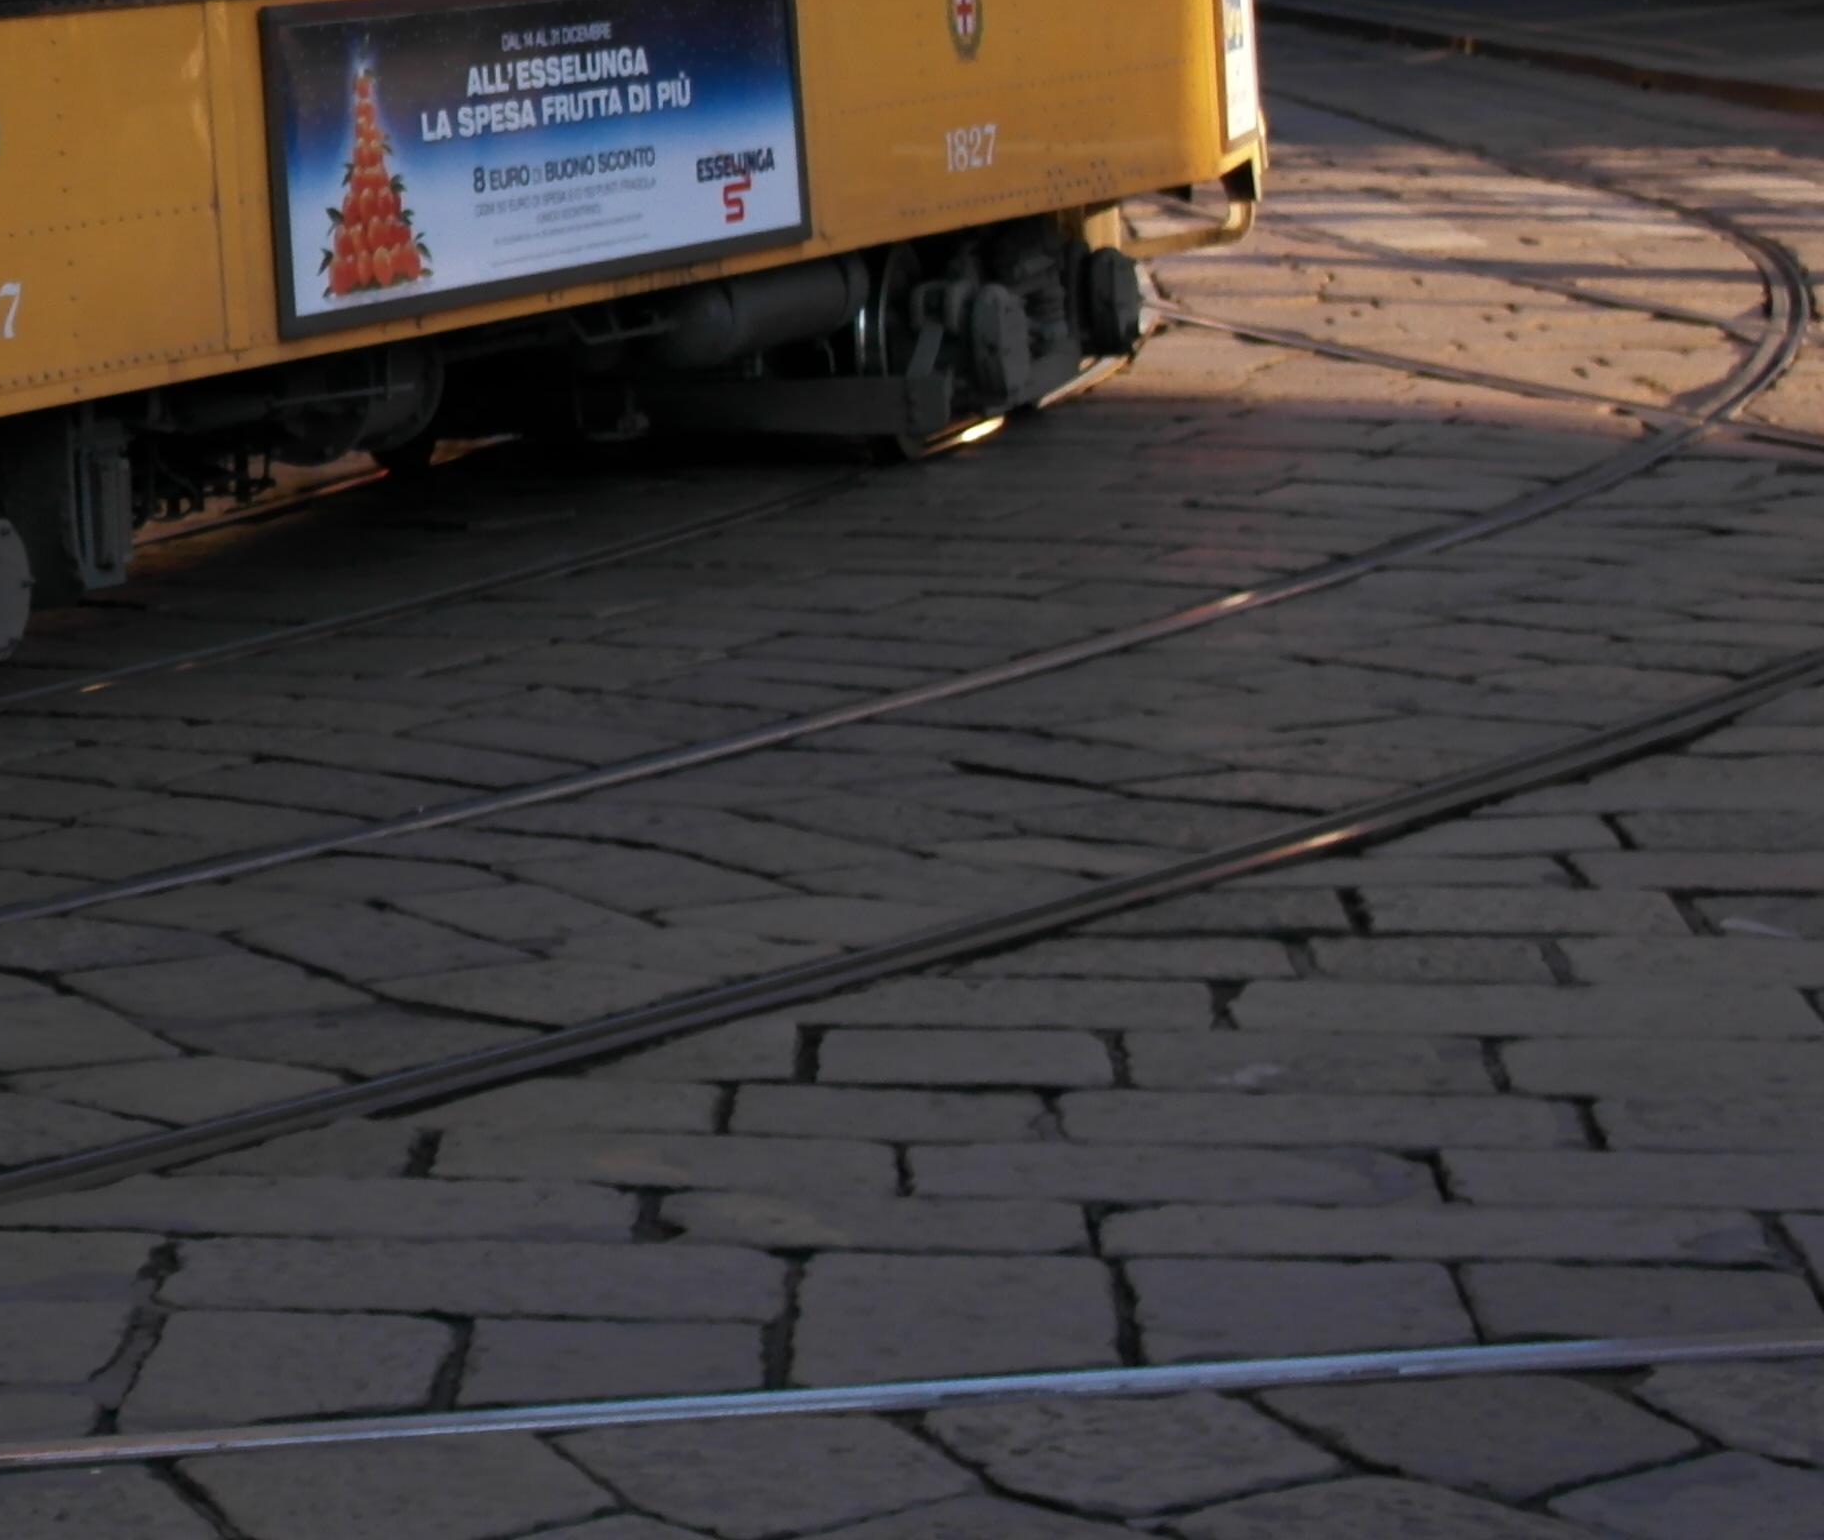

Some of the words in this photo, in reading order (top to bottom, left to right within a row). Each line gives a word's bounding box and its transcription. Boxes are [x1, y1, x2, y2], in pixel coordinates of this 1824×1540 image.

[561, 21, 612, 44] DICEMBRE
[466, 45, 649, 97] ALL'ESSELUNGA
[421, 108, 453, 142] LA
[457, 98, 537, 138] SPESA
[541, 85, 623, 125] FRUTTA
[627, 82, 652, 113] DI
[656, 71, 692, 109] PIÙ
[473, 165, 486, 193] 8
[489, 164, 530, 191] EURO
[545, 155, 596, 182] BUONO
[598, 146, 656, 173] SCONTO
[696, 147, 775, 183] ESSELUNGA
[945, 124, 997, 173] 1827
